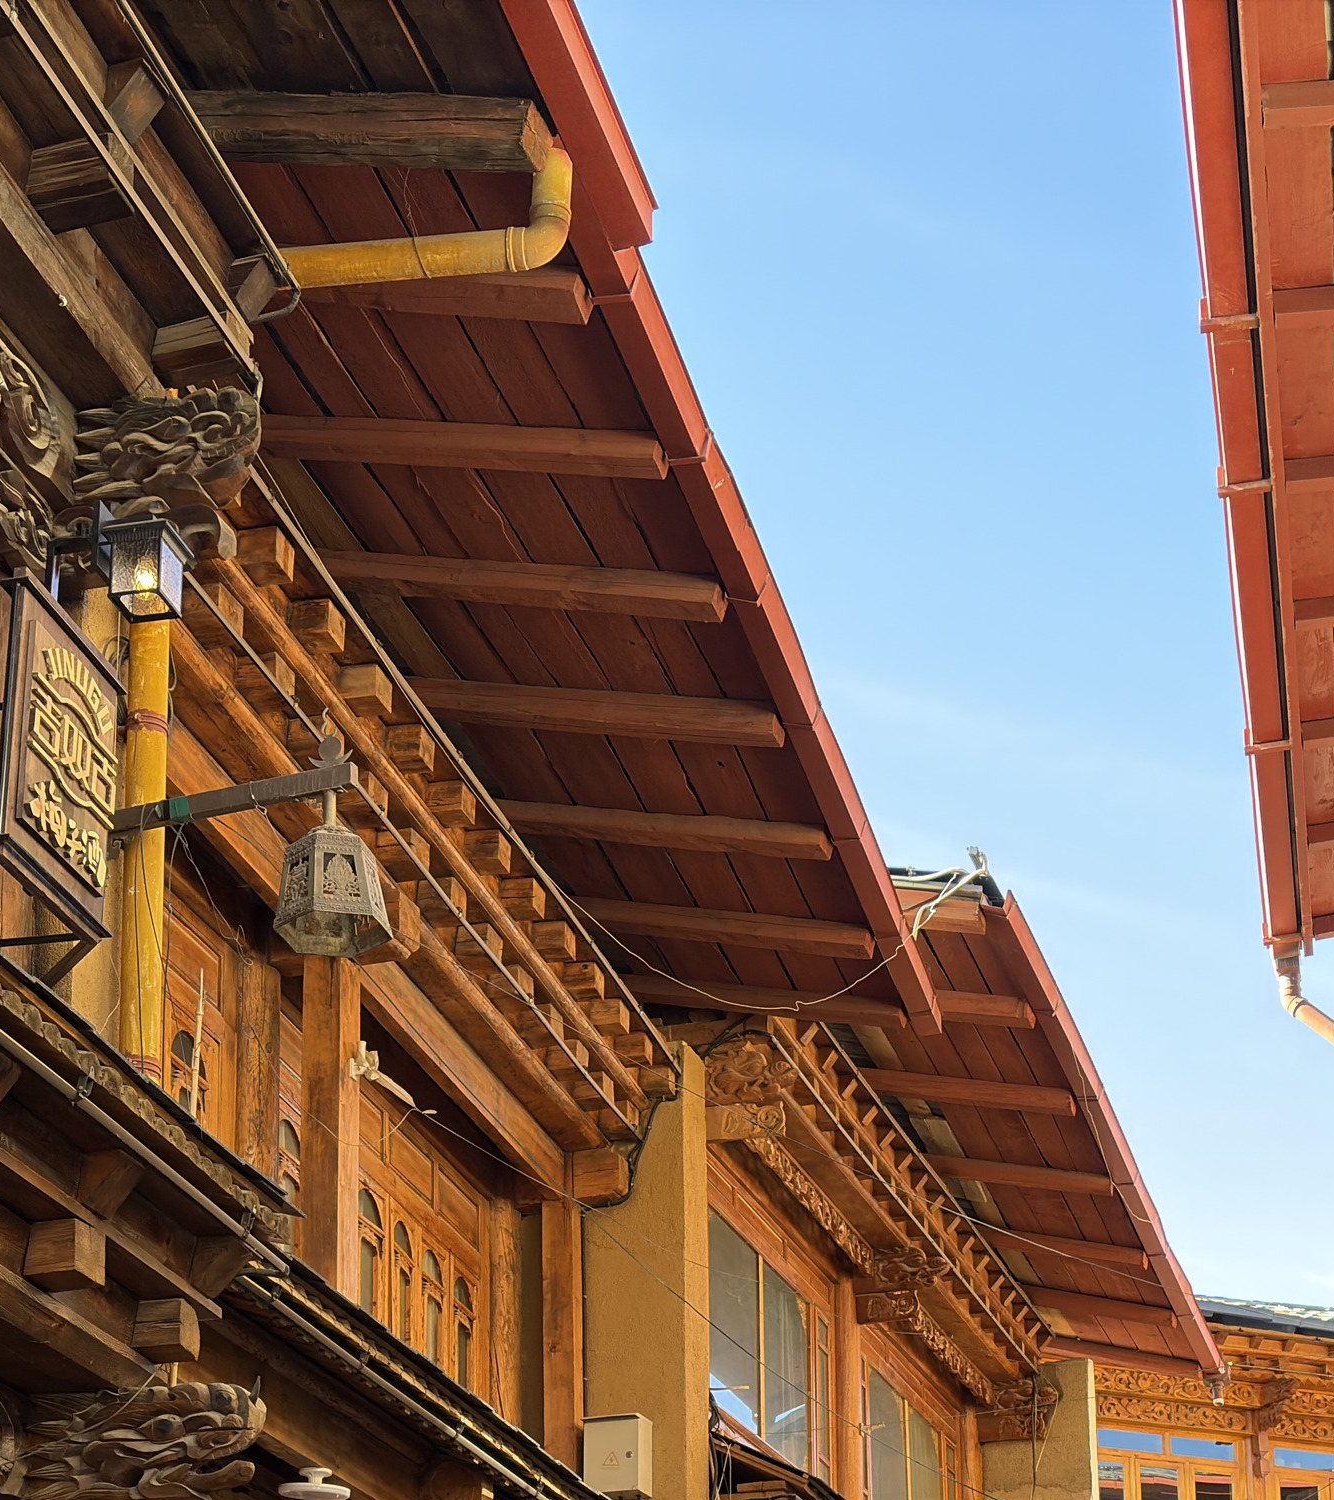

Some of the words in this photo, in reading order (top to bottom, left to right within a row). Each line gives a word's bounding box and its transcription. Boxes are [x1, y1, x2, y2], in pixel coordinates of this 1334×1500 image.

[43, 648, 114, 735] JINUGU
[26, 779, 107, 887] 梅子酒
